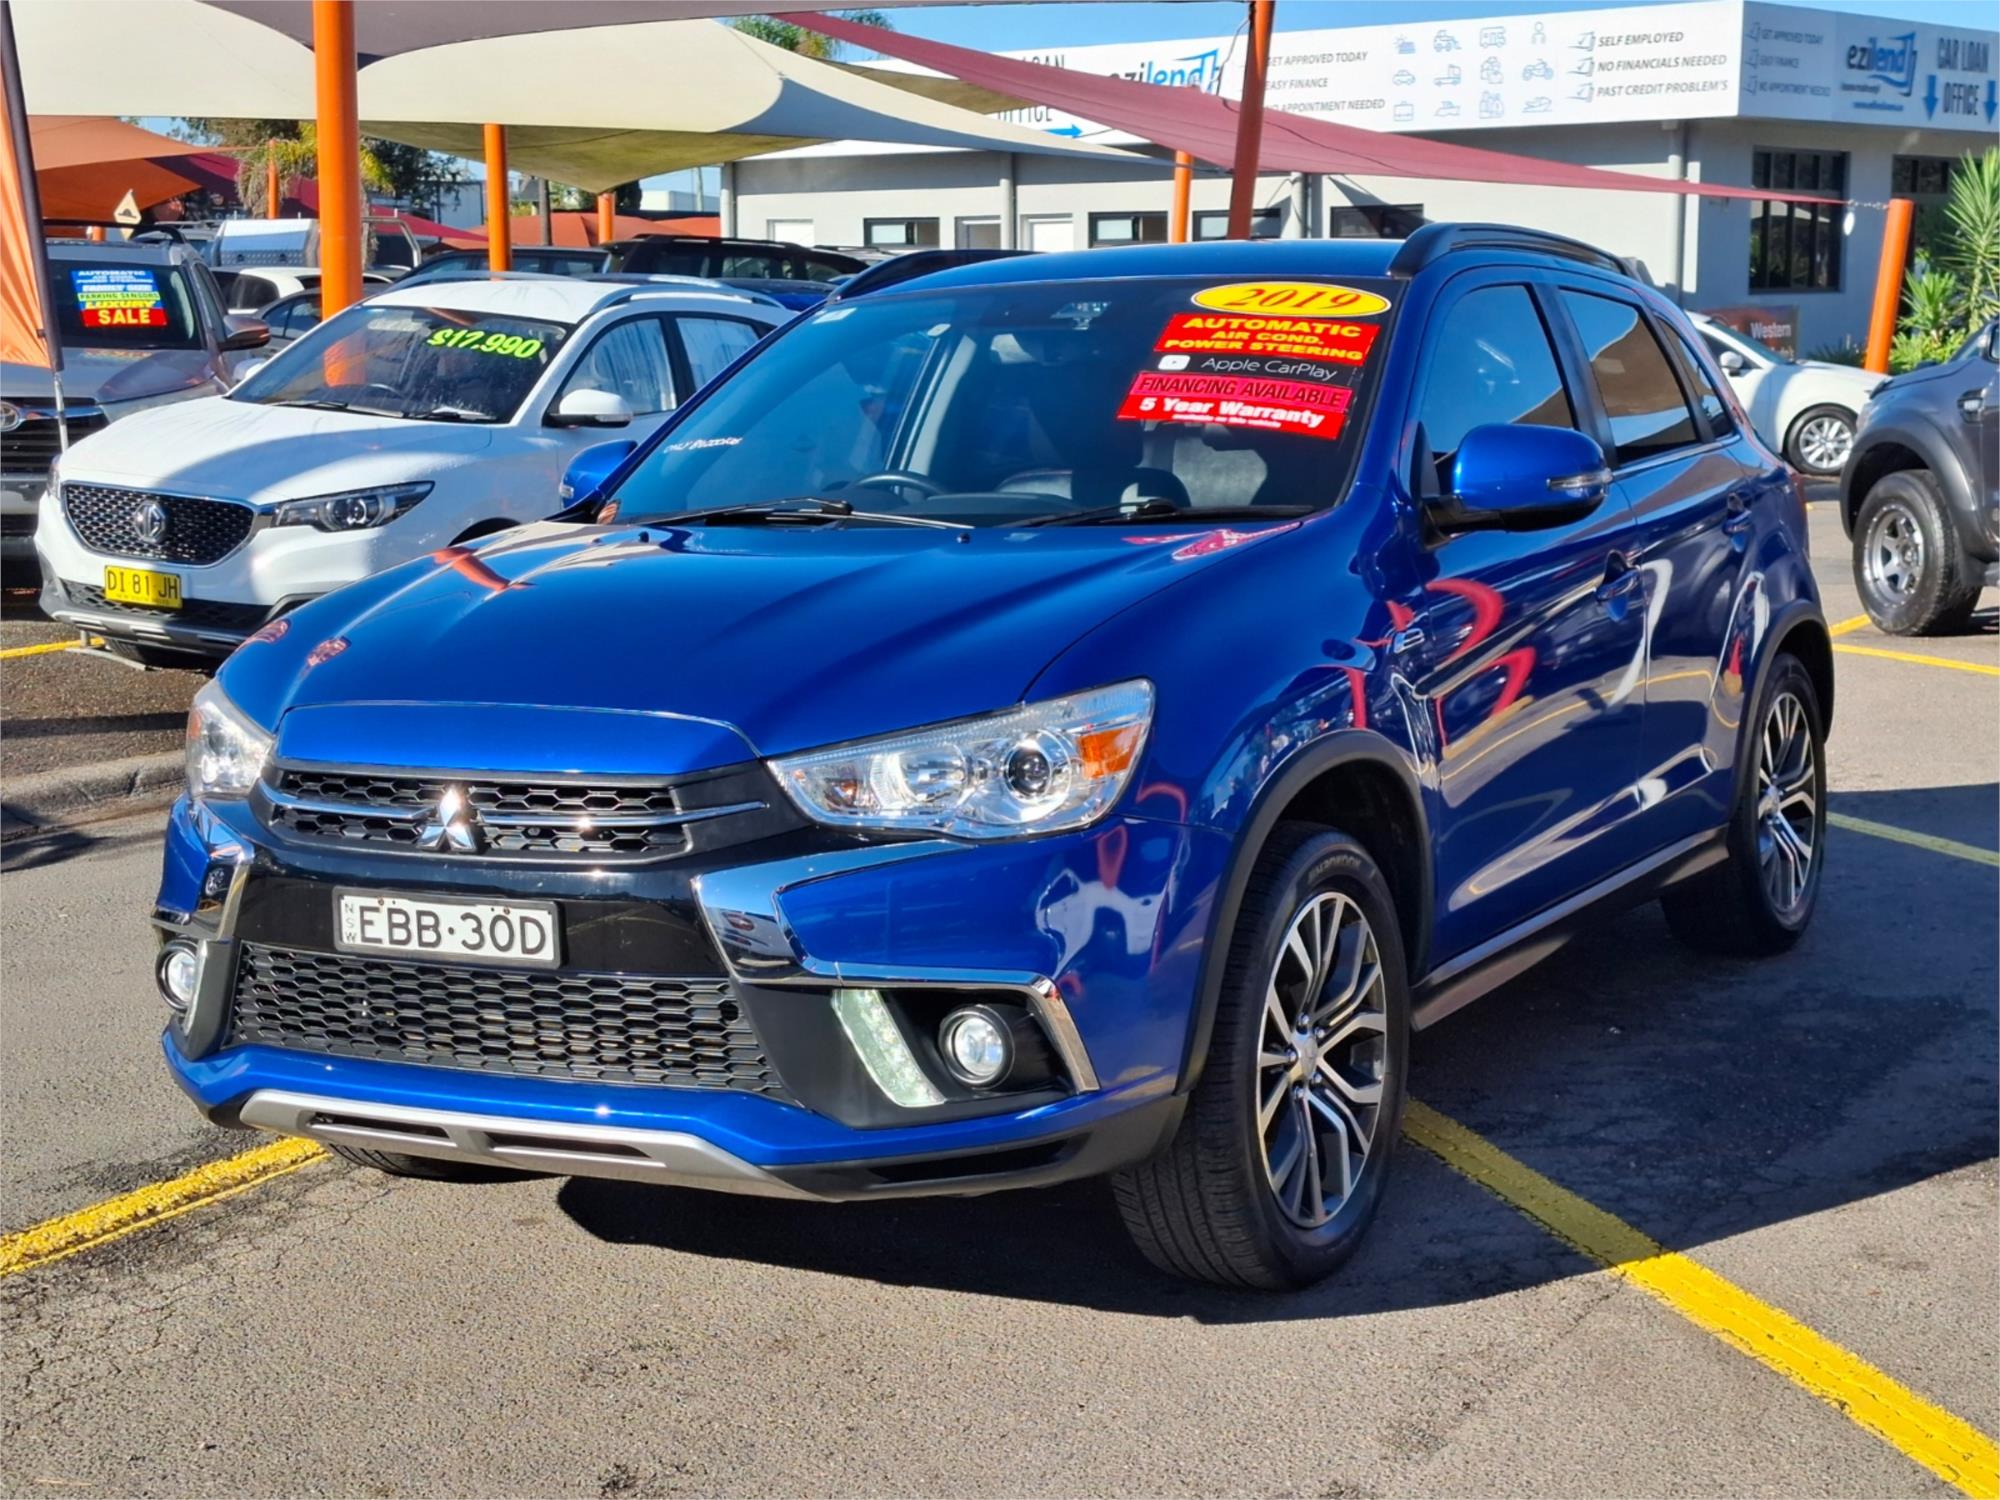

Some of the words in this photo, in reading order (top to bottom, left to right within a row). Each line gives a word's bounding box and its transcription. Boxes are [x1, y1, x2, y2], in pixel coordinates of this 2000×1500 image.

[1598, 35, 1623, 47] SELF
[1624, 31, 1684, 45] EMPLOYED
[1284, 53, 1334, 65] APPROVED
[1335, 51, 1368, 62] TODAY
[1597, 61, 1614, 72] NO
[1616, 57, 1680, 71] FINANCIALS
[1681, 54, 1728, 67] NEEDED
[1938, 37, 1959, 70] CAR
[1961, 40, 1990, 73] LOAN
[1288, 77, 1328, 89] FINANCE
[1597, 85, 1623, 97] PAST
[1625, 83, 1664, 96] CREDIT
[1665, 80, 1729, 93] PROBLEM'S
[1348, 98, 1386, 109] NEEDED
[1943, 82, 1980, 116] OFFICE
[1223, 288, 1361, 309] 2019
[98, 308, 151, 325] SALE
[1183, 317, 1362, 338] AUTOMATIC
[1750, 322, 1792, 339] Western
[1211, 330, 1250, 340] AIR
[1256, 332, 1324, 345] COND.
[1164, 339, 1245, 350] POWER
[1248, 341, 1363, 360] STEERING
[1200, 357, 1260, 372] Apple
[1264, 360, 1337, 381] CarPlay
[1138, 378, 1237, 396] FINANCING
[1240, 381, 1344, 407] AVAILABLE
[1139, 397, 1158, 411] 5
[1163, 397, 1215, 414] Year
[1218, 399, 1325, 428] Warranty
[158, 577, 178, 600] JH
